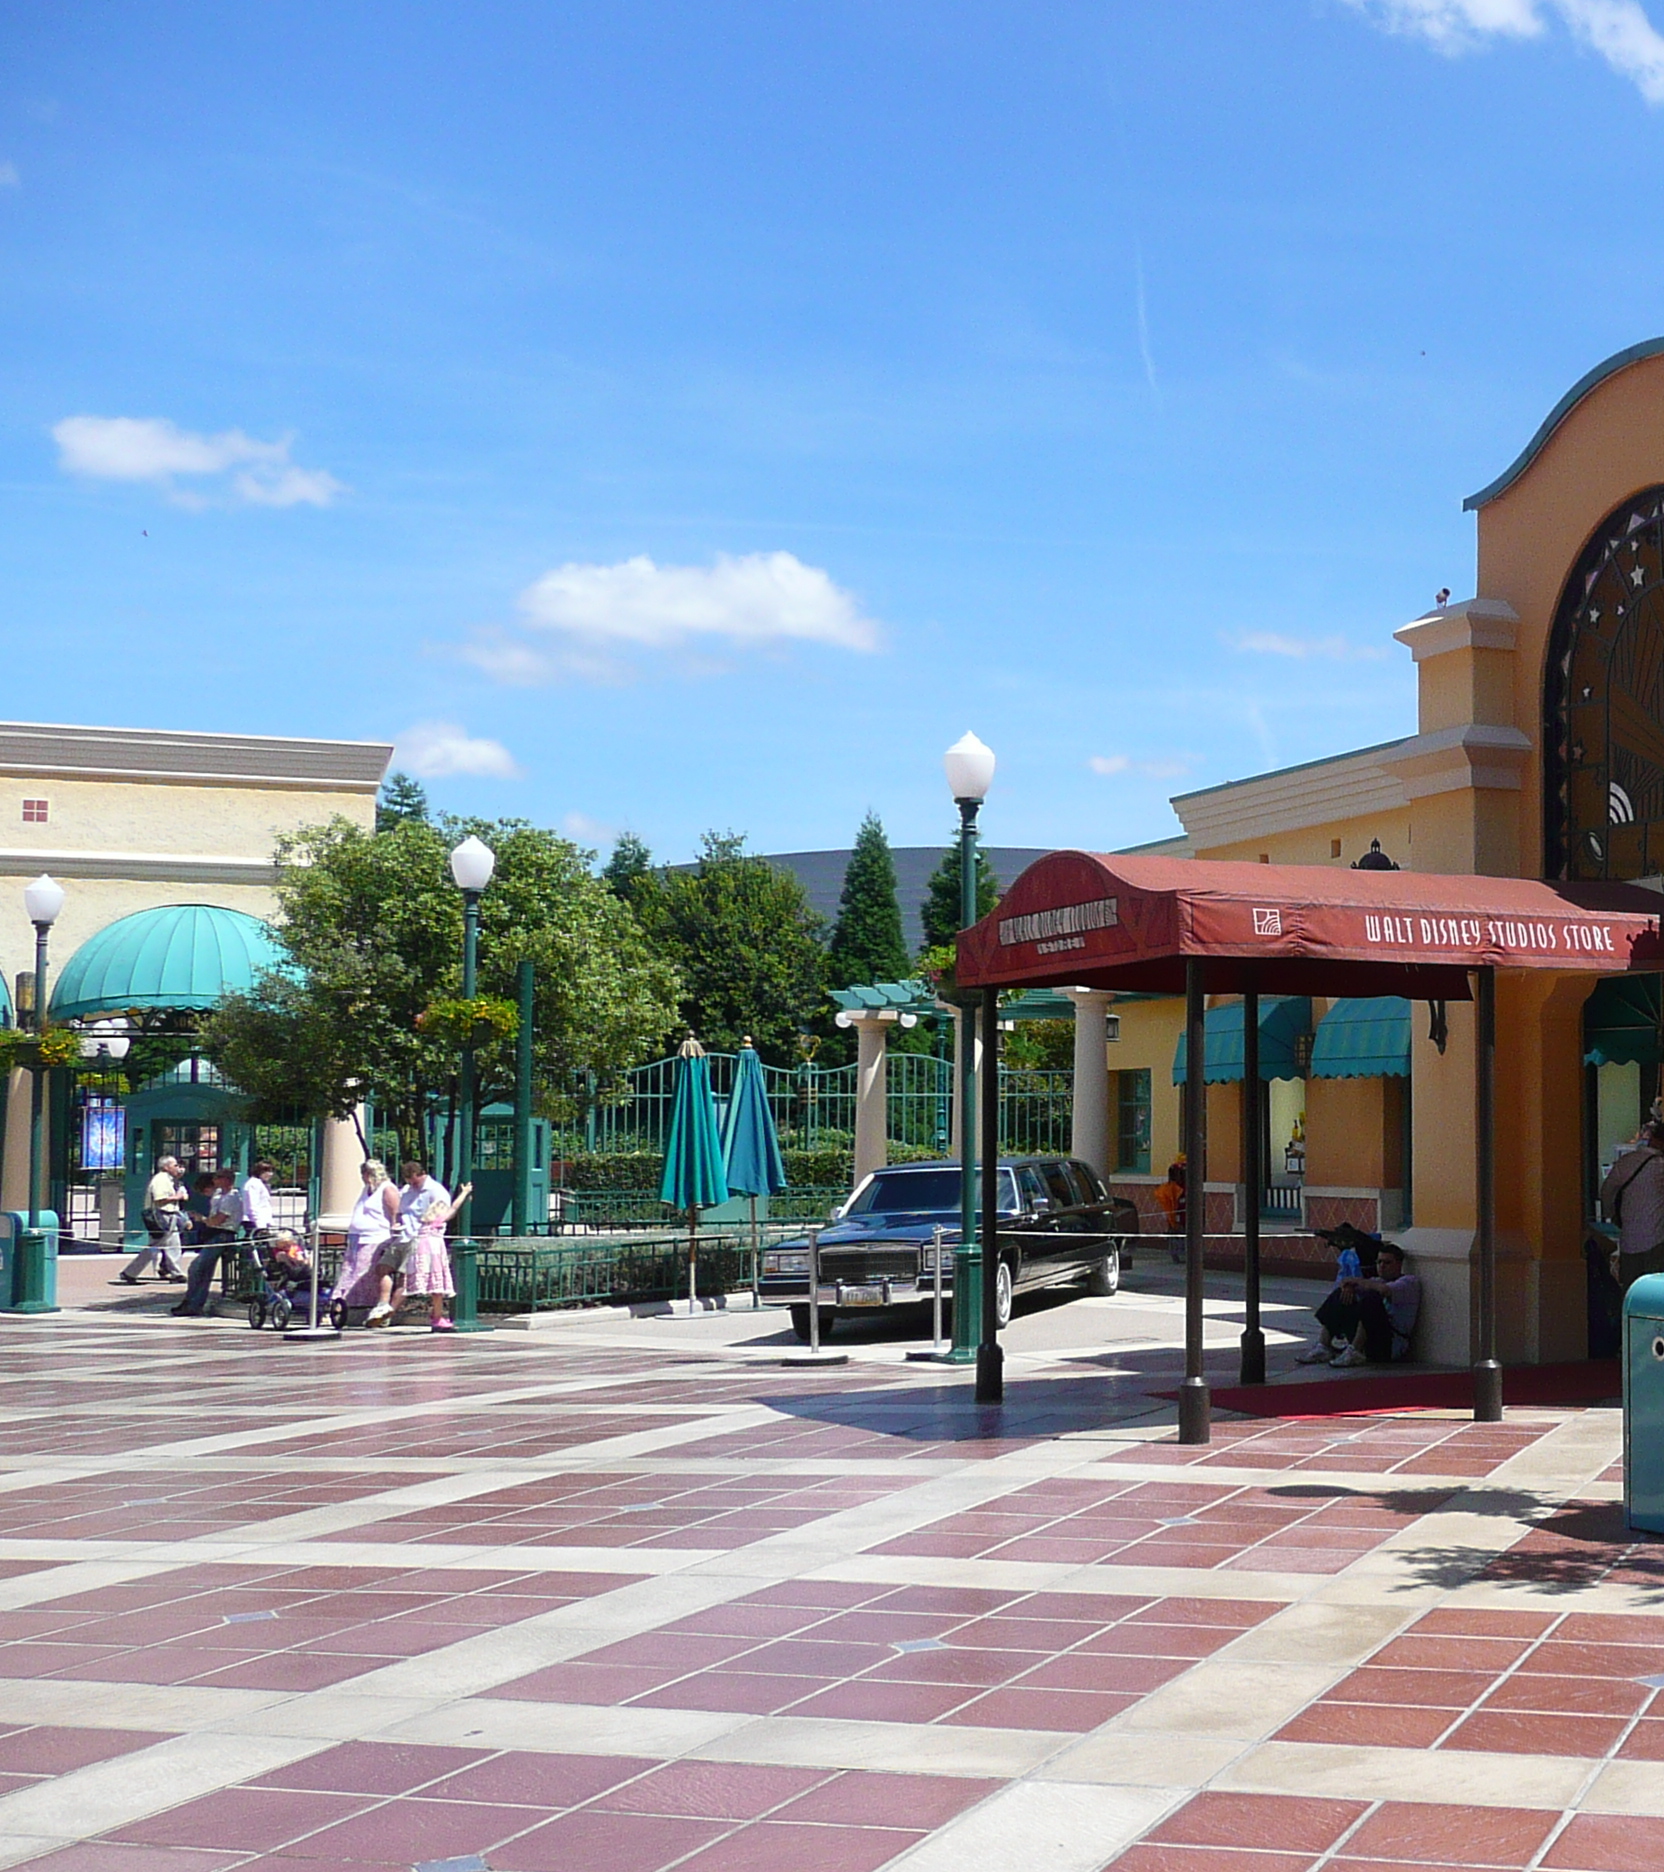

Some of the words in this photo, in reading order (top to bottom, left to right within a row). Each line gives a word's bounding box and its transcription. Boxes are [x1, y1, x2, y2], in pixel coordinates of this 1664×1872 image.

[1365, 914, 1413, 943] WALT
[1420, 919, 1480, 946] DISNEY
[1488, 921, 1556, 949] STUDIOS
[1563, 925, 1614, 951] STORE
